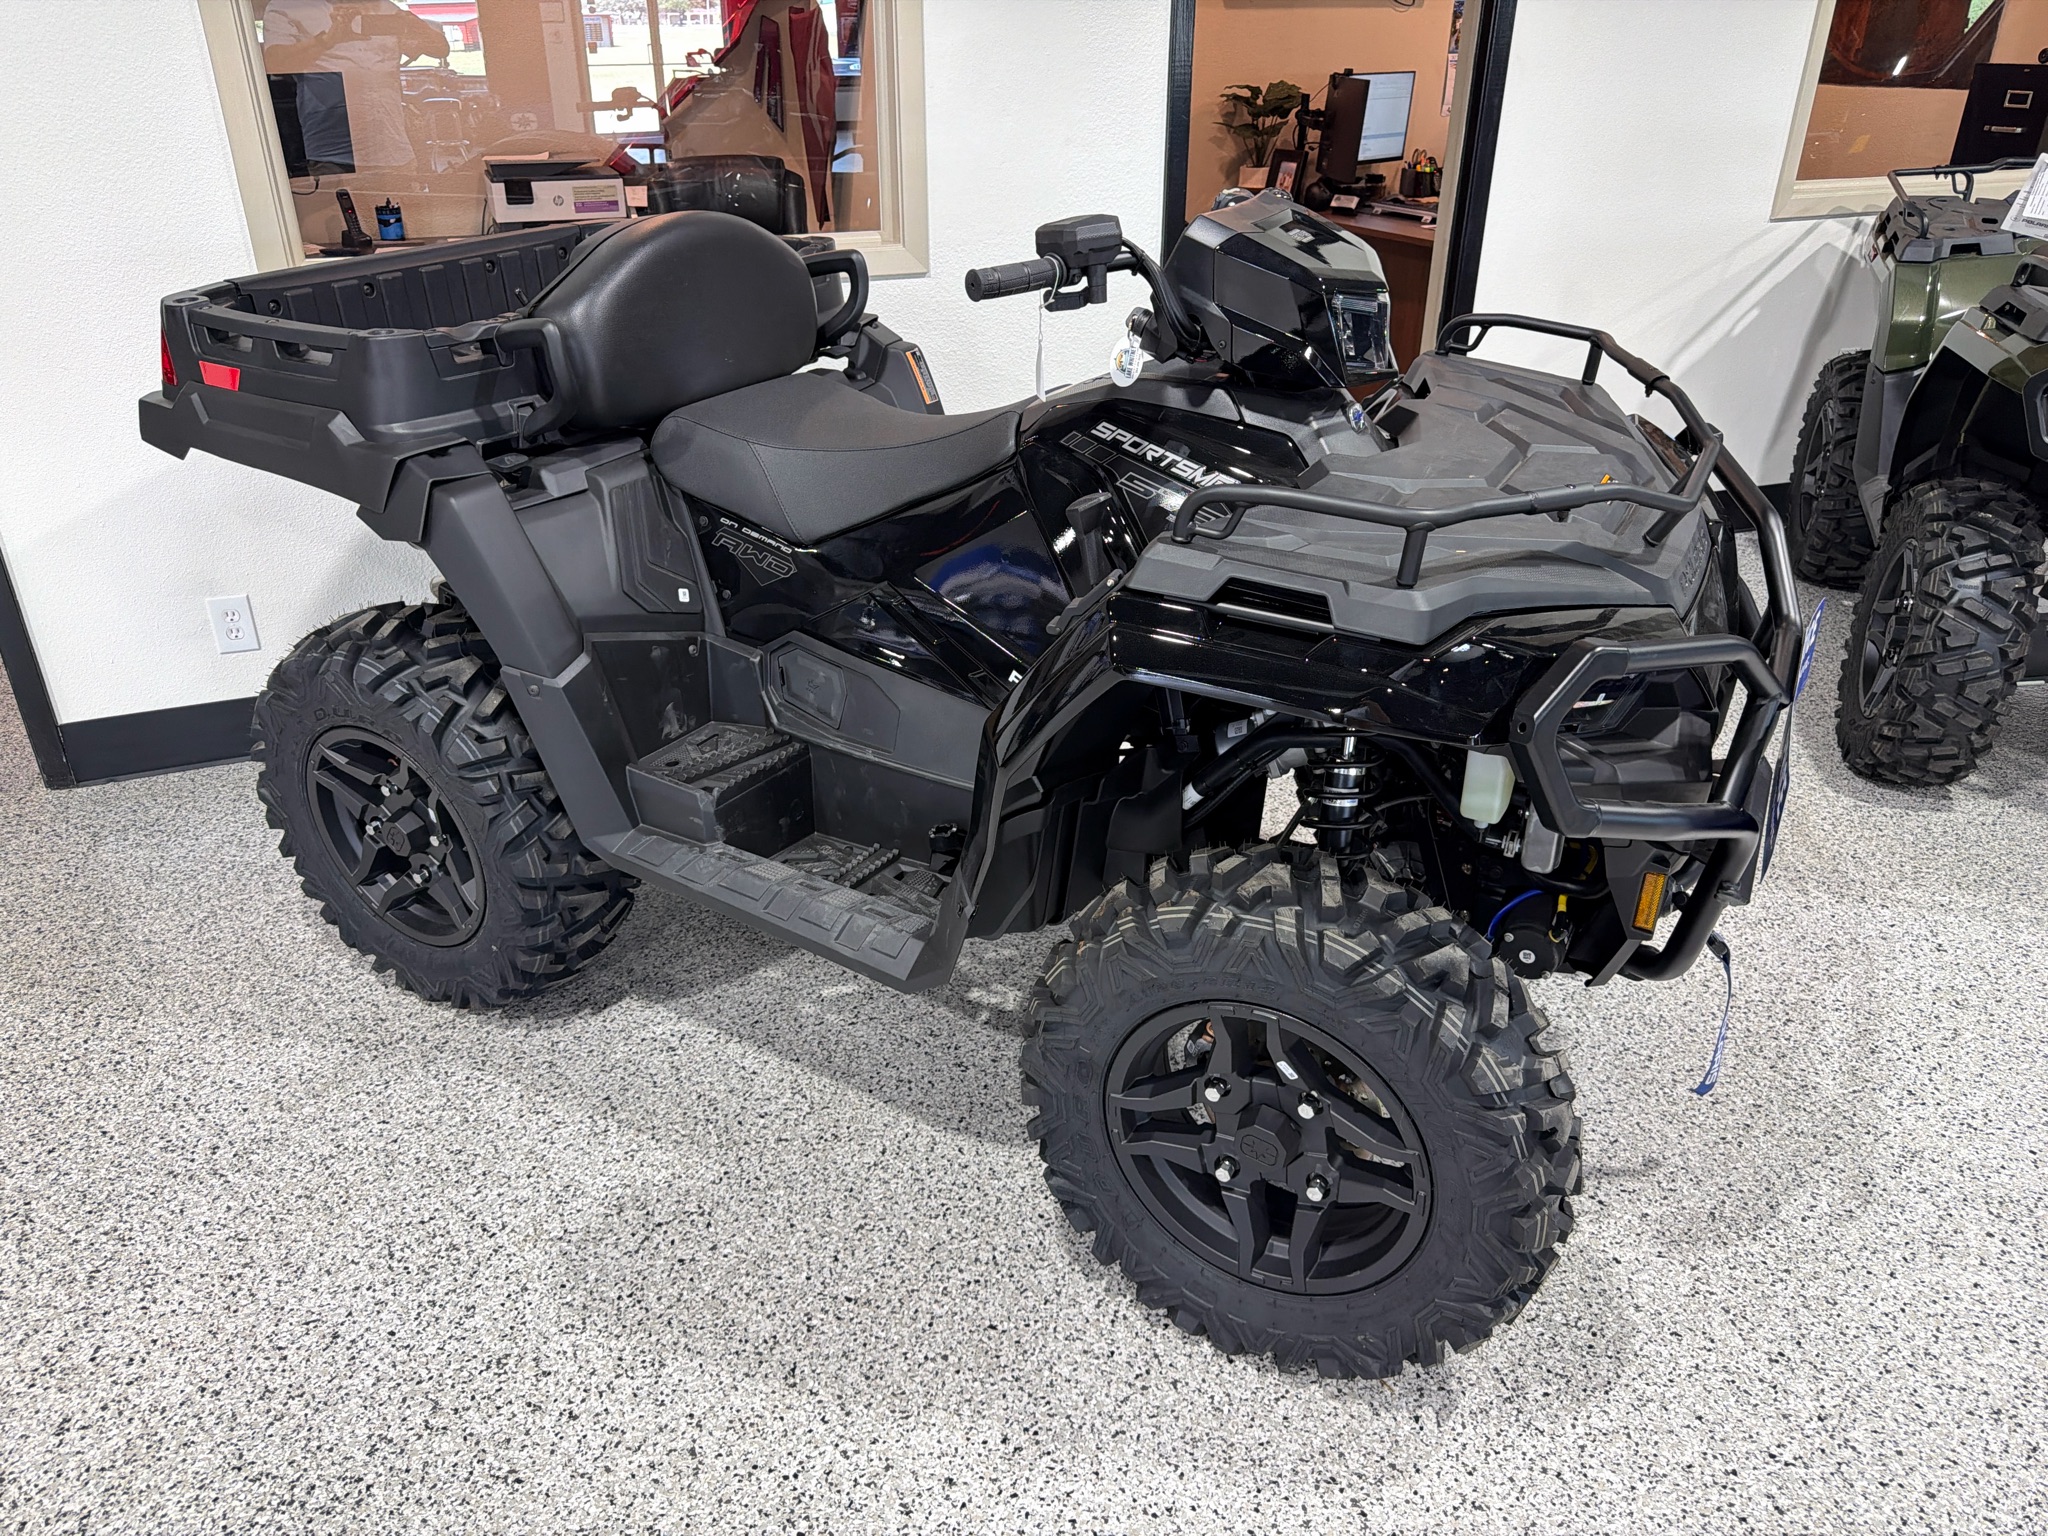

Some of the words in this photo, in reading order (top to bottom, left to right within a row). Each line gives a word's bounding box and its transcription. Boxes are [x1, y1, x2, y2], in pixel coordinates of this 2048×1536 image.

[2022, 218, 2048, 228] POLARI
[1091, 422, 1242, 486] SPORTSMA
[712, 532, 796, 577] AWD
